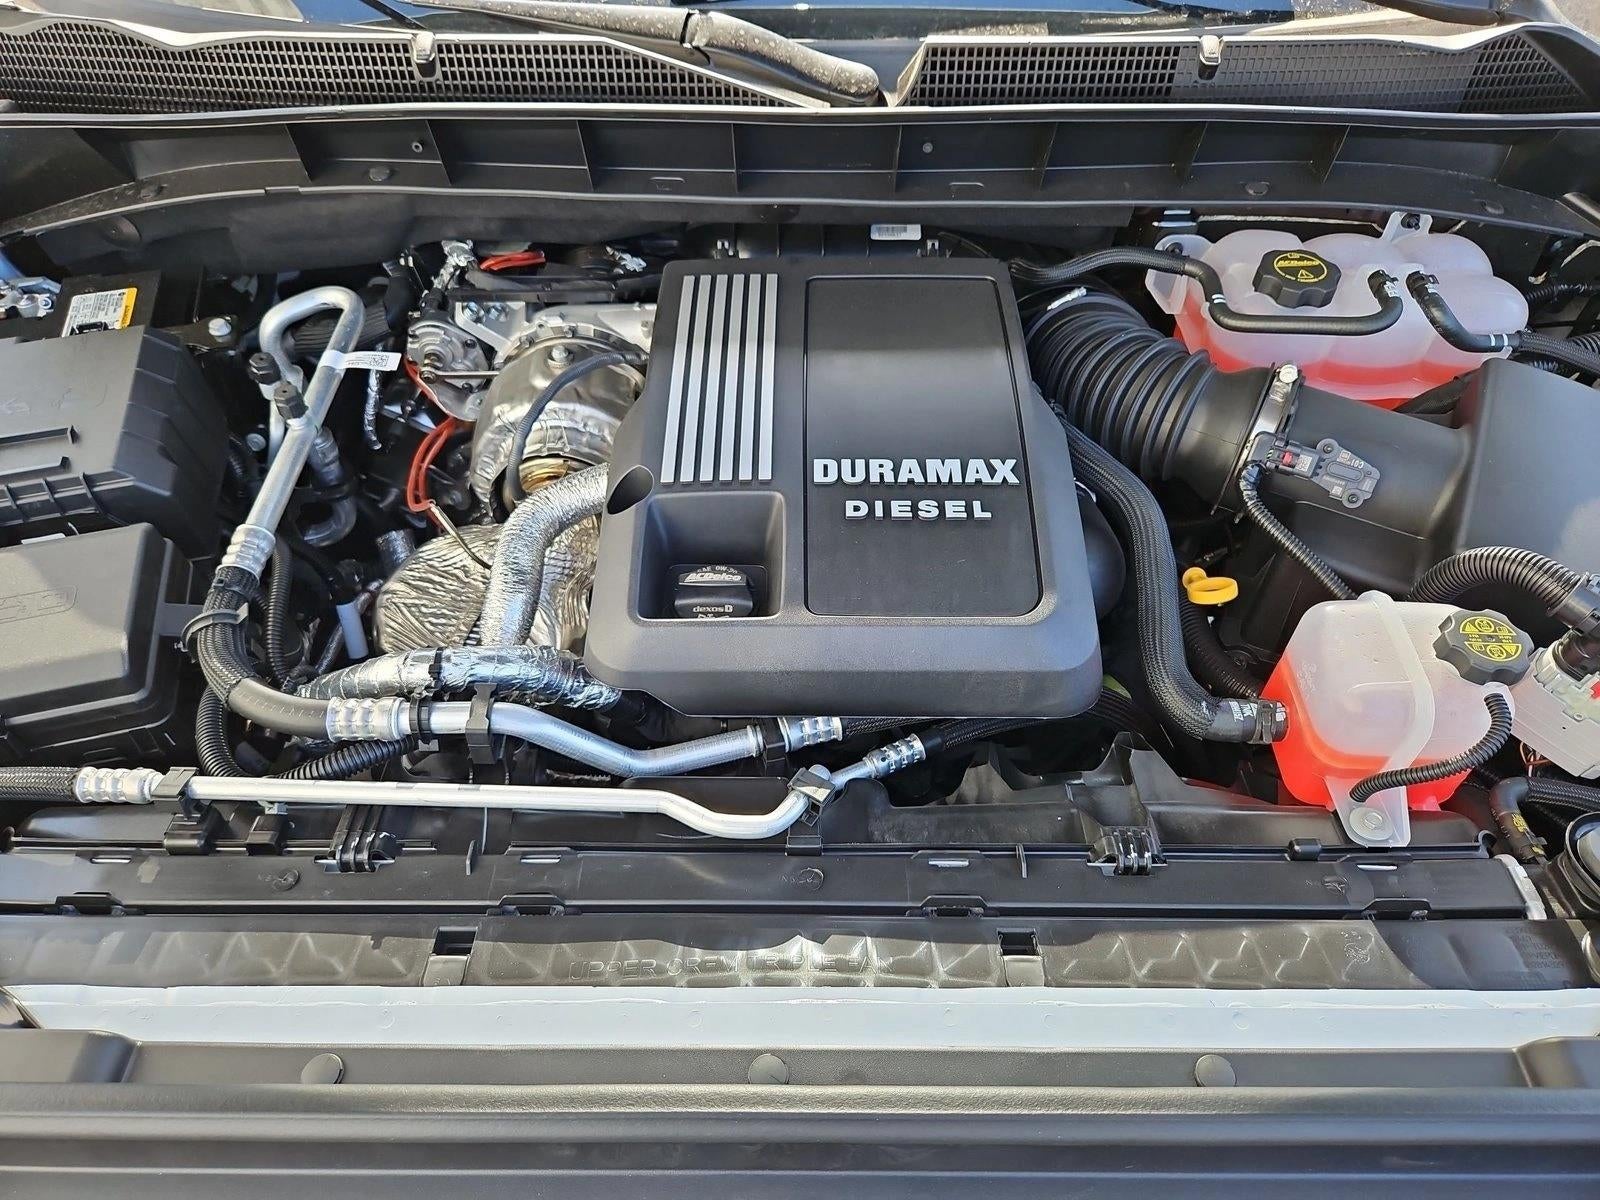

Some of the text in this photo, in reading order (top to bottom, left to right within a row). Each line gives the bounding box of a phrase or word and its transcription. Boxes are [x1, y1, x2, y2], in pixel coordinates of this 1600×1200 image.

[813, 458, 1020, 485] DURAMAX
[845, 500, 992, 520] DIESEL
[683, 572, 742, 583] ACDelco
[568, 959, 657, 981] UPPER
[747, 953, 837, 973] TRPLE
[848, 956, 896, 975] FAN
